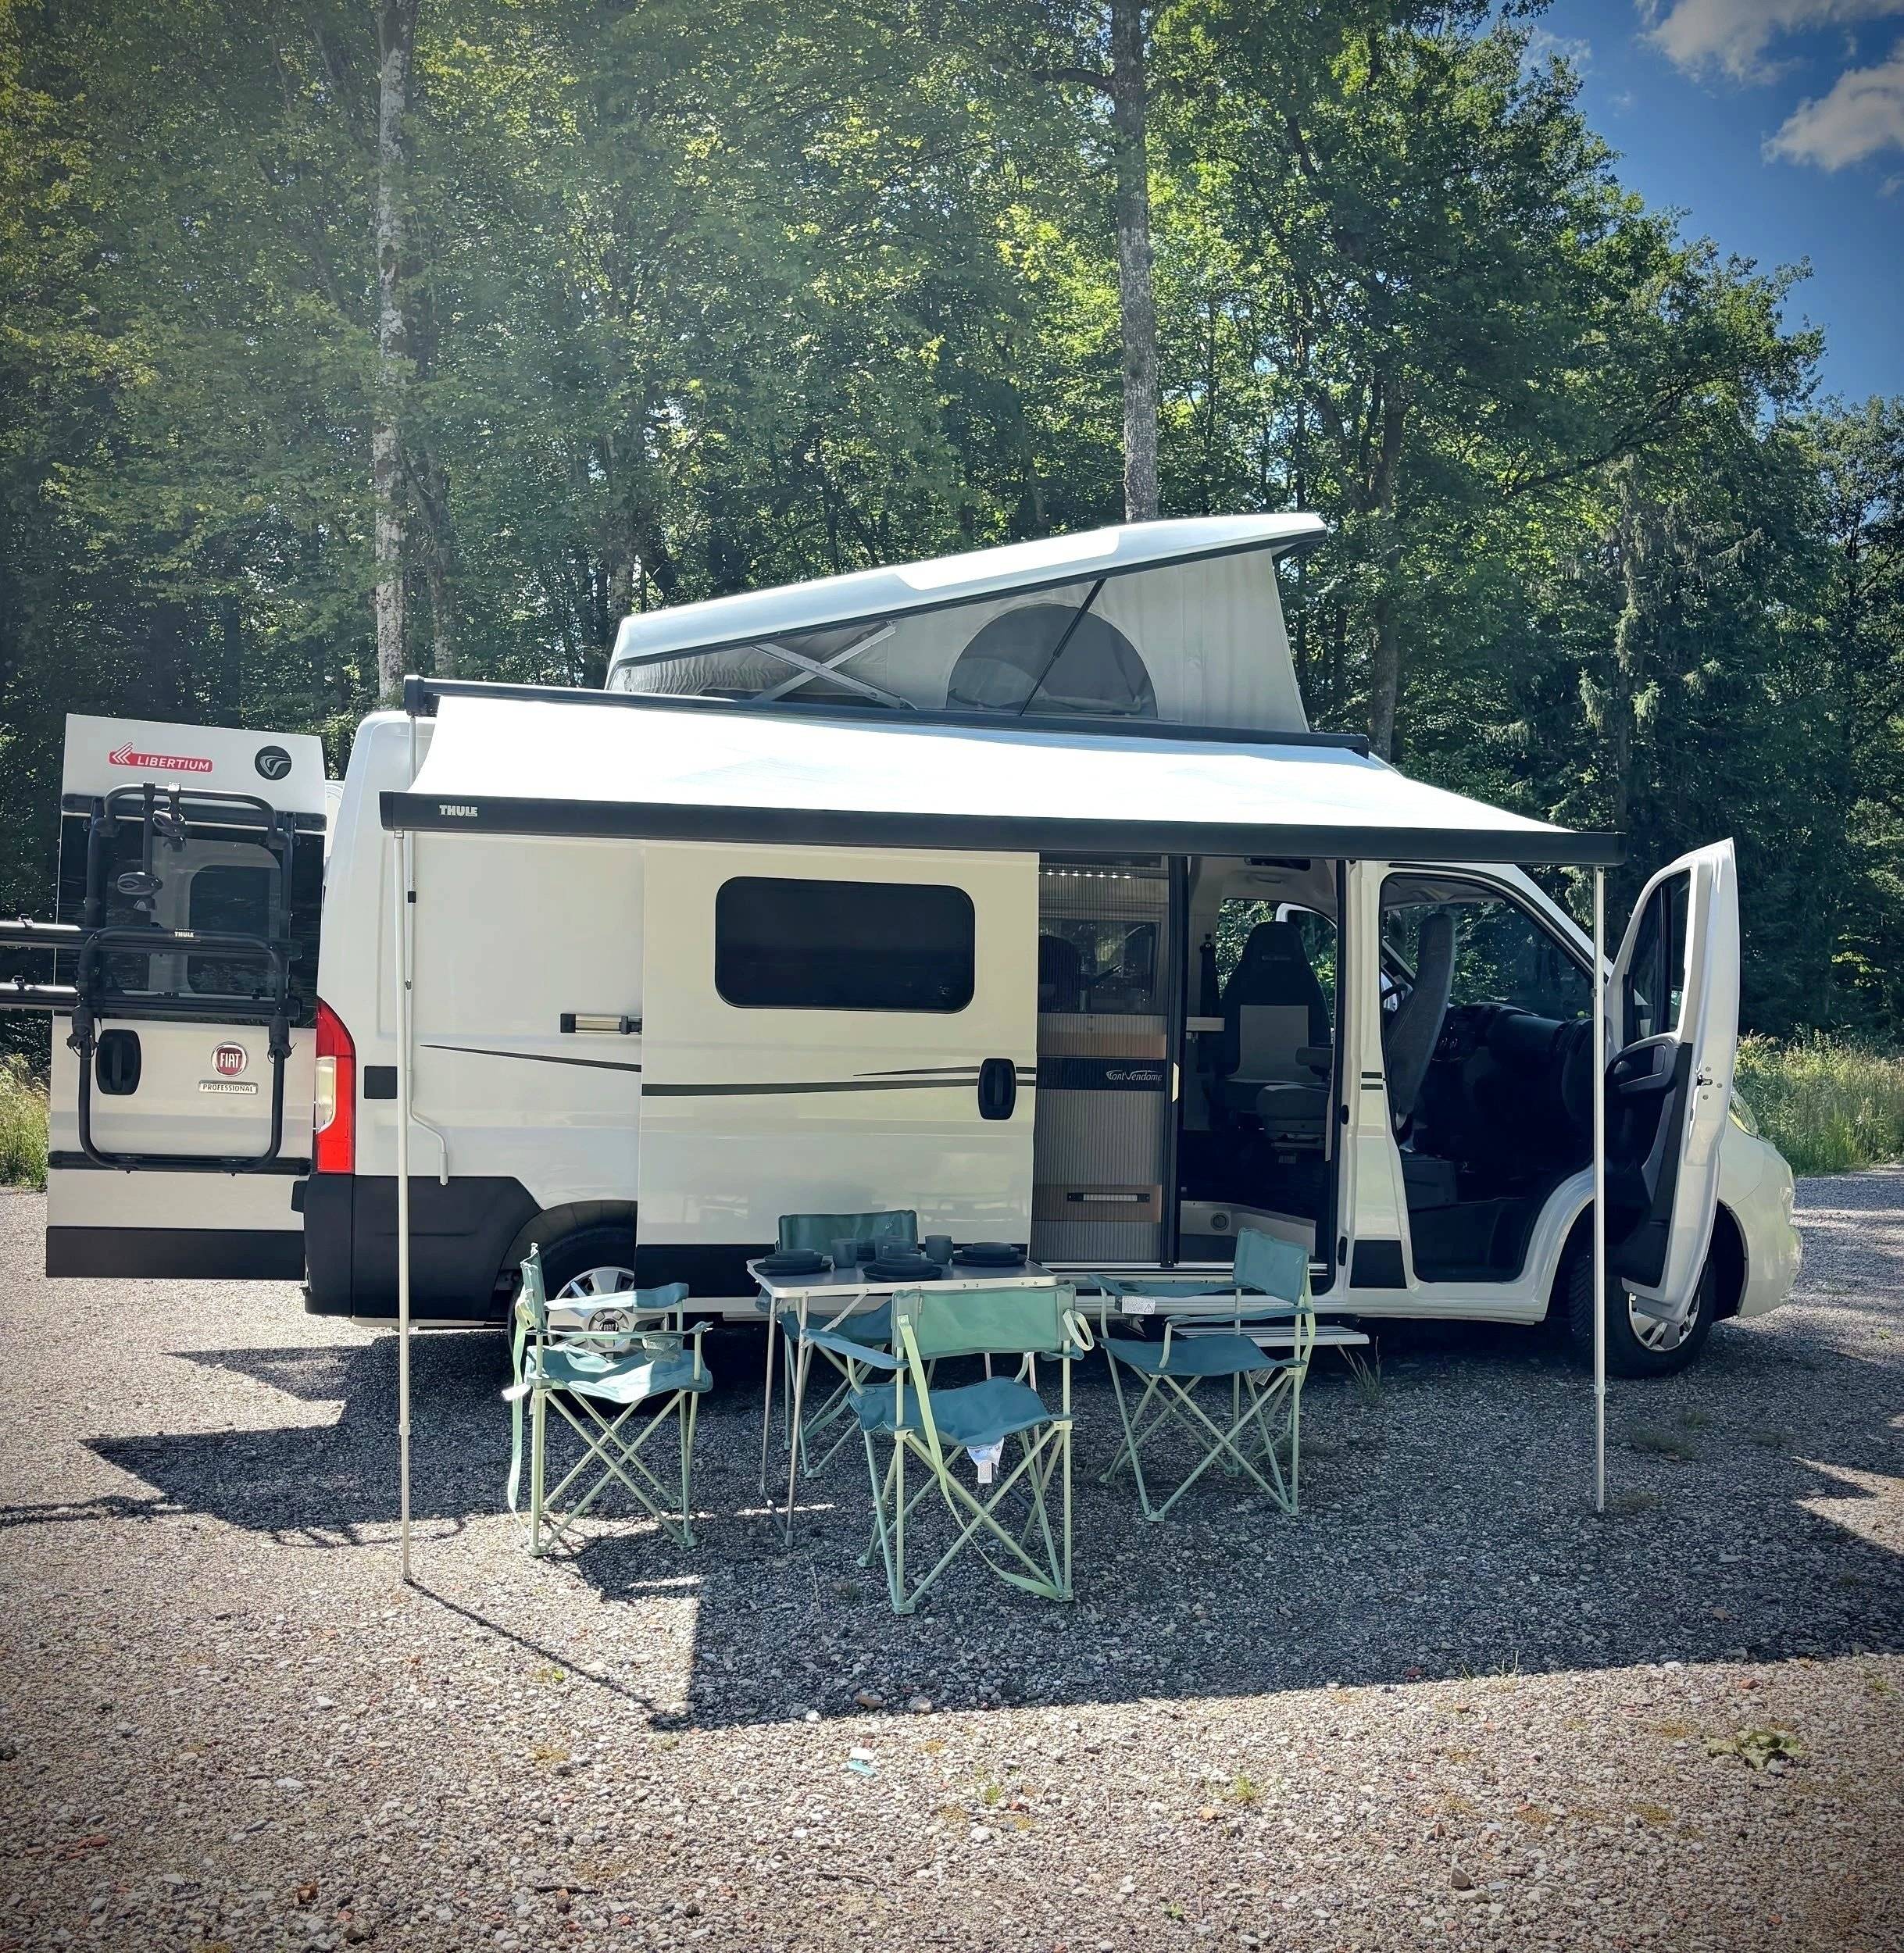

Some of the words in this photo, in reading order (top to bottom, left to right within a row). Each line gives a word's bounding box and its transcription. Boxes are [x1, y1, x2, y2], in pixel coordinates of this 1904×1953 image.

[137, 755, 209, 770] LIBERTIUM
[439, 805, 478, 817] THULE
[220, 1052, 241, 1068] FIAT
[202, 1084, 253, 1092] PROFESSIONAL
